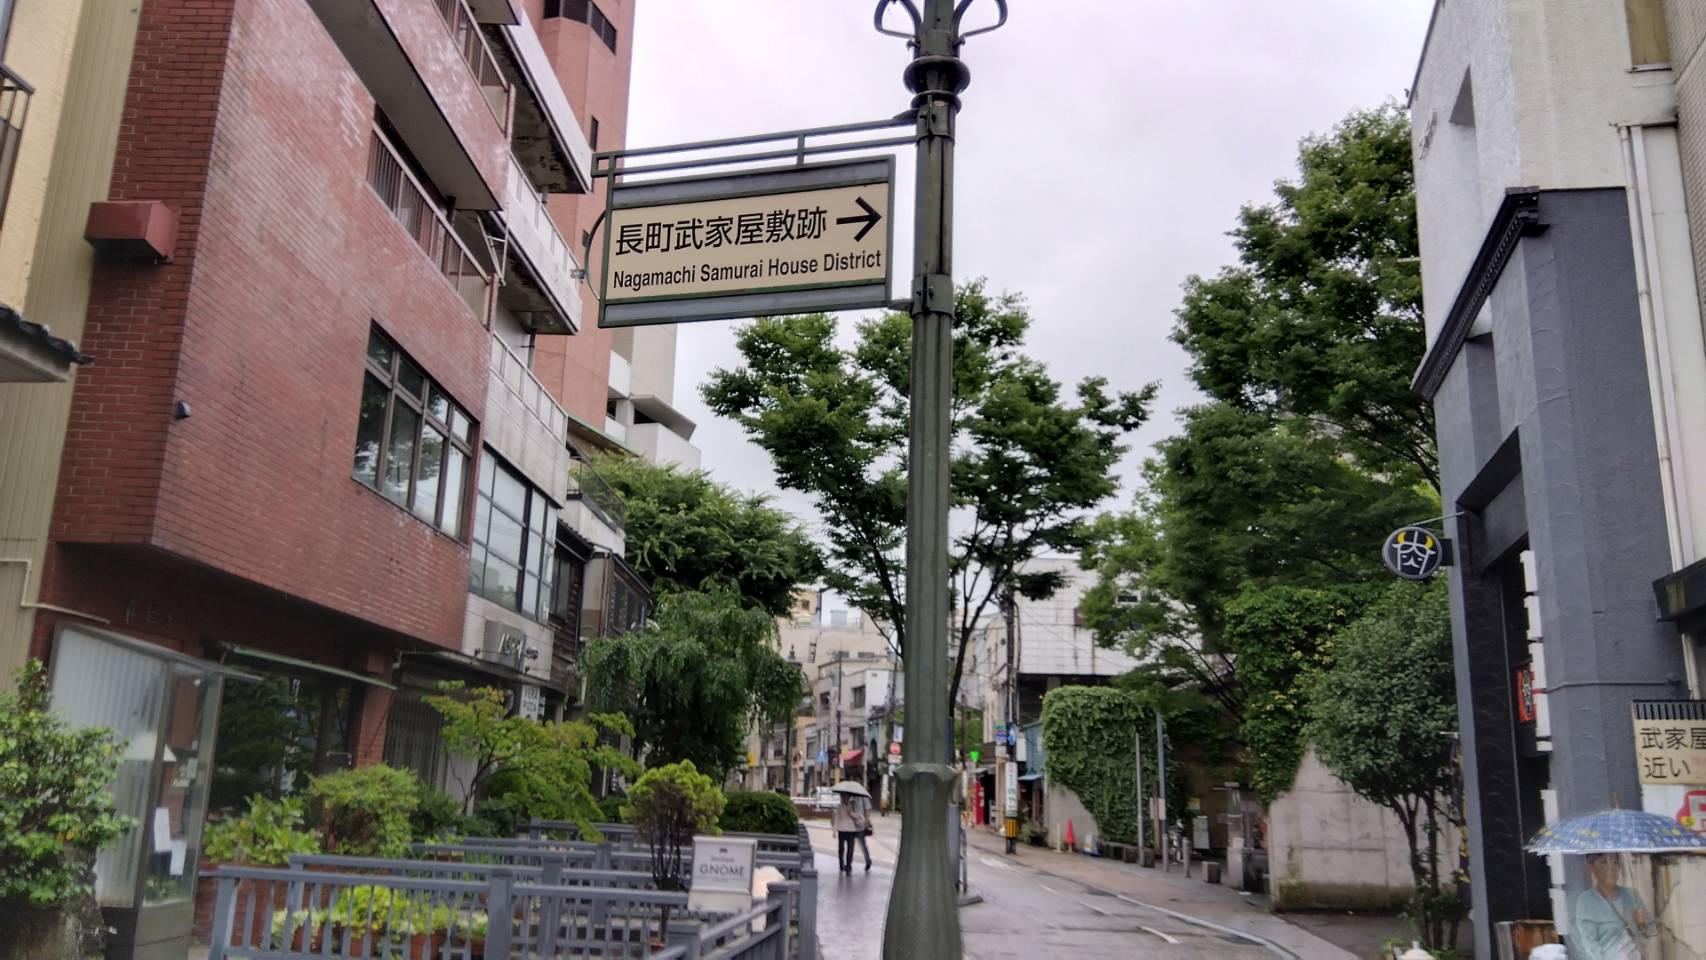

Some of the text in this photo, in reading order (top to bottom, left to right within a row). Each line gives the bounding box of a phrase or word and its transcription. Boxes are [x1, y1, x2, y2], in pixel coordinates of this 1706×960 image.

[616, 206, 828, 256] 長町武家屋敷跡
[613, 249, 881, 291] Nagamachi Samurai House District
[1643, 757, 1691, 779] 近い
[699, 863, 745, 877] GNOME
